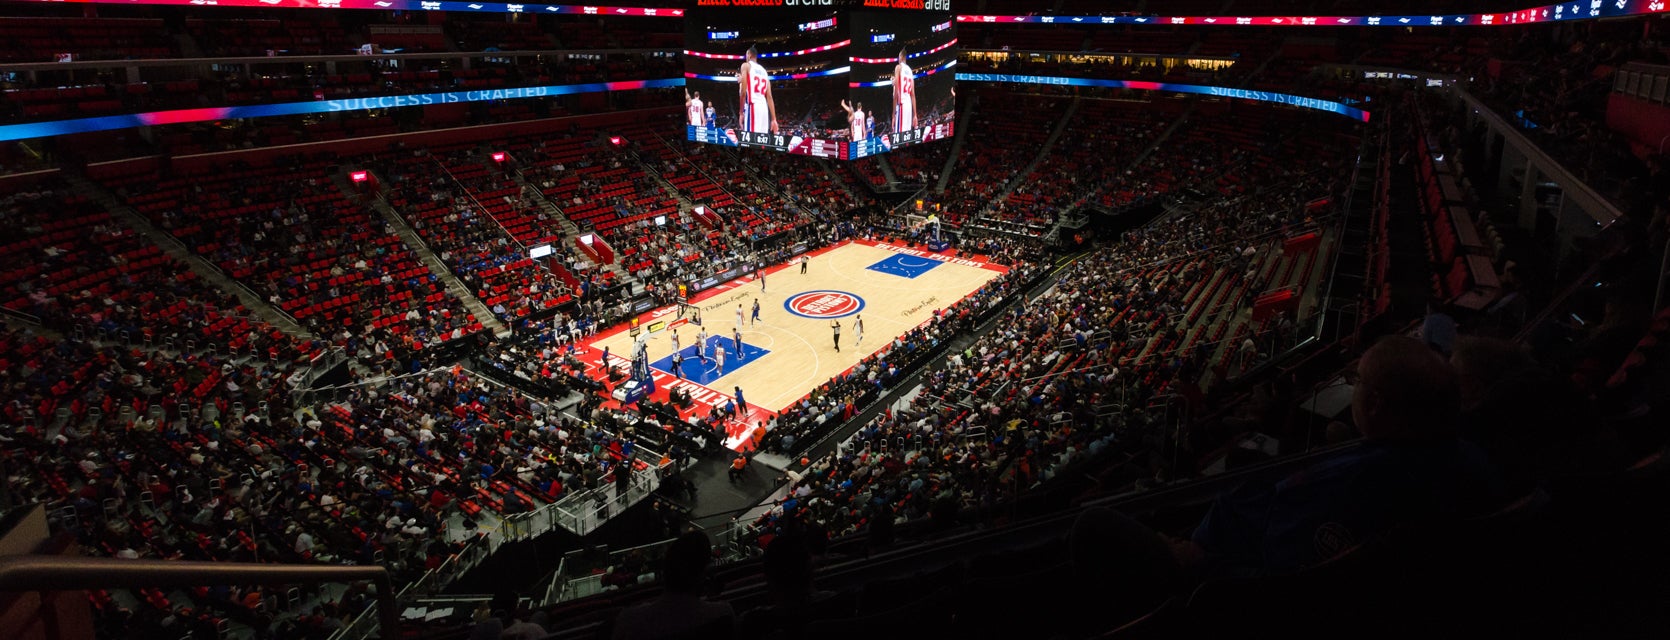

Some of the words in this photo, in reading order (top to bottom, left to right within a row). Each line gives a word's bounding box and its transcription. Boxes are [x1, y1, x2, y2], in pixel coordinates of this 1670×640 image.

[753, 76, 767, 95] 22
[903, 76, 913, 95] 22
[1012, 75, 1070, 85] CRAFTED
[328, 94, 433, 112] SUCCESS
[441, 92, 458, 104] IS
[466, 86, 547, 102] CRAFTED
[1210, 86, 1269, 101] SUCCESS
[1274, 93, 1285, 103] IS
[1288, 95, 1338, 112] CRAFTED
[741, 131, 751, 143] 74
[774, 135, 784, 147] 79
[892, 133, 900, 144] 74
[874, 243, 927, 256] DETROIT
[928, 253, 986, 268] PISTONS
